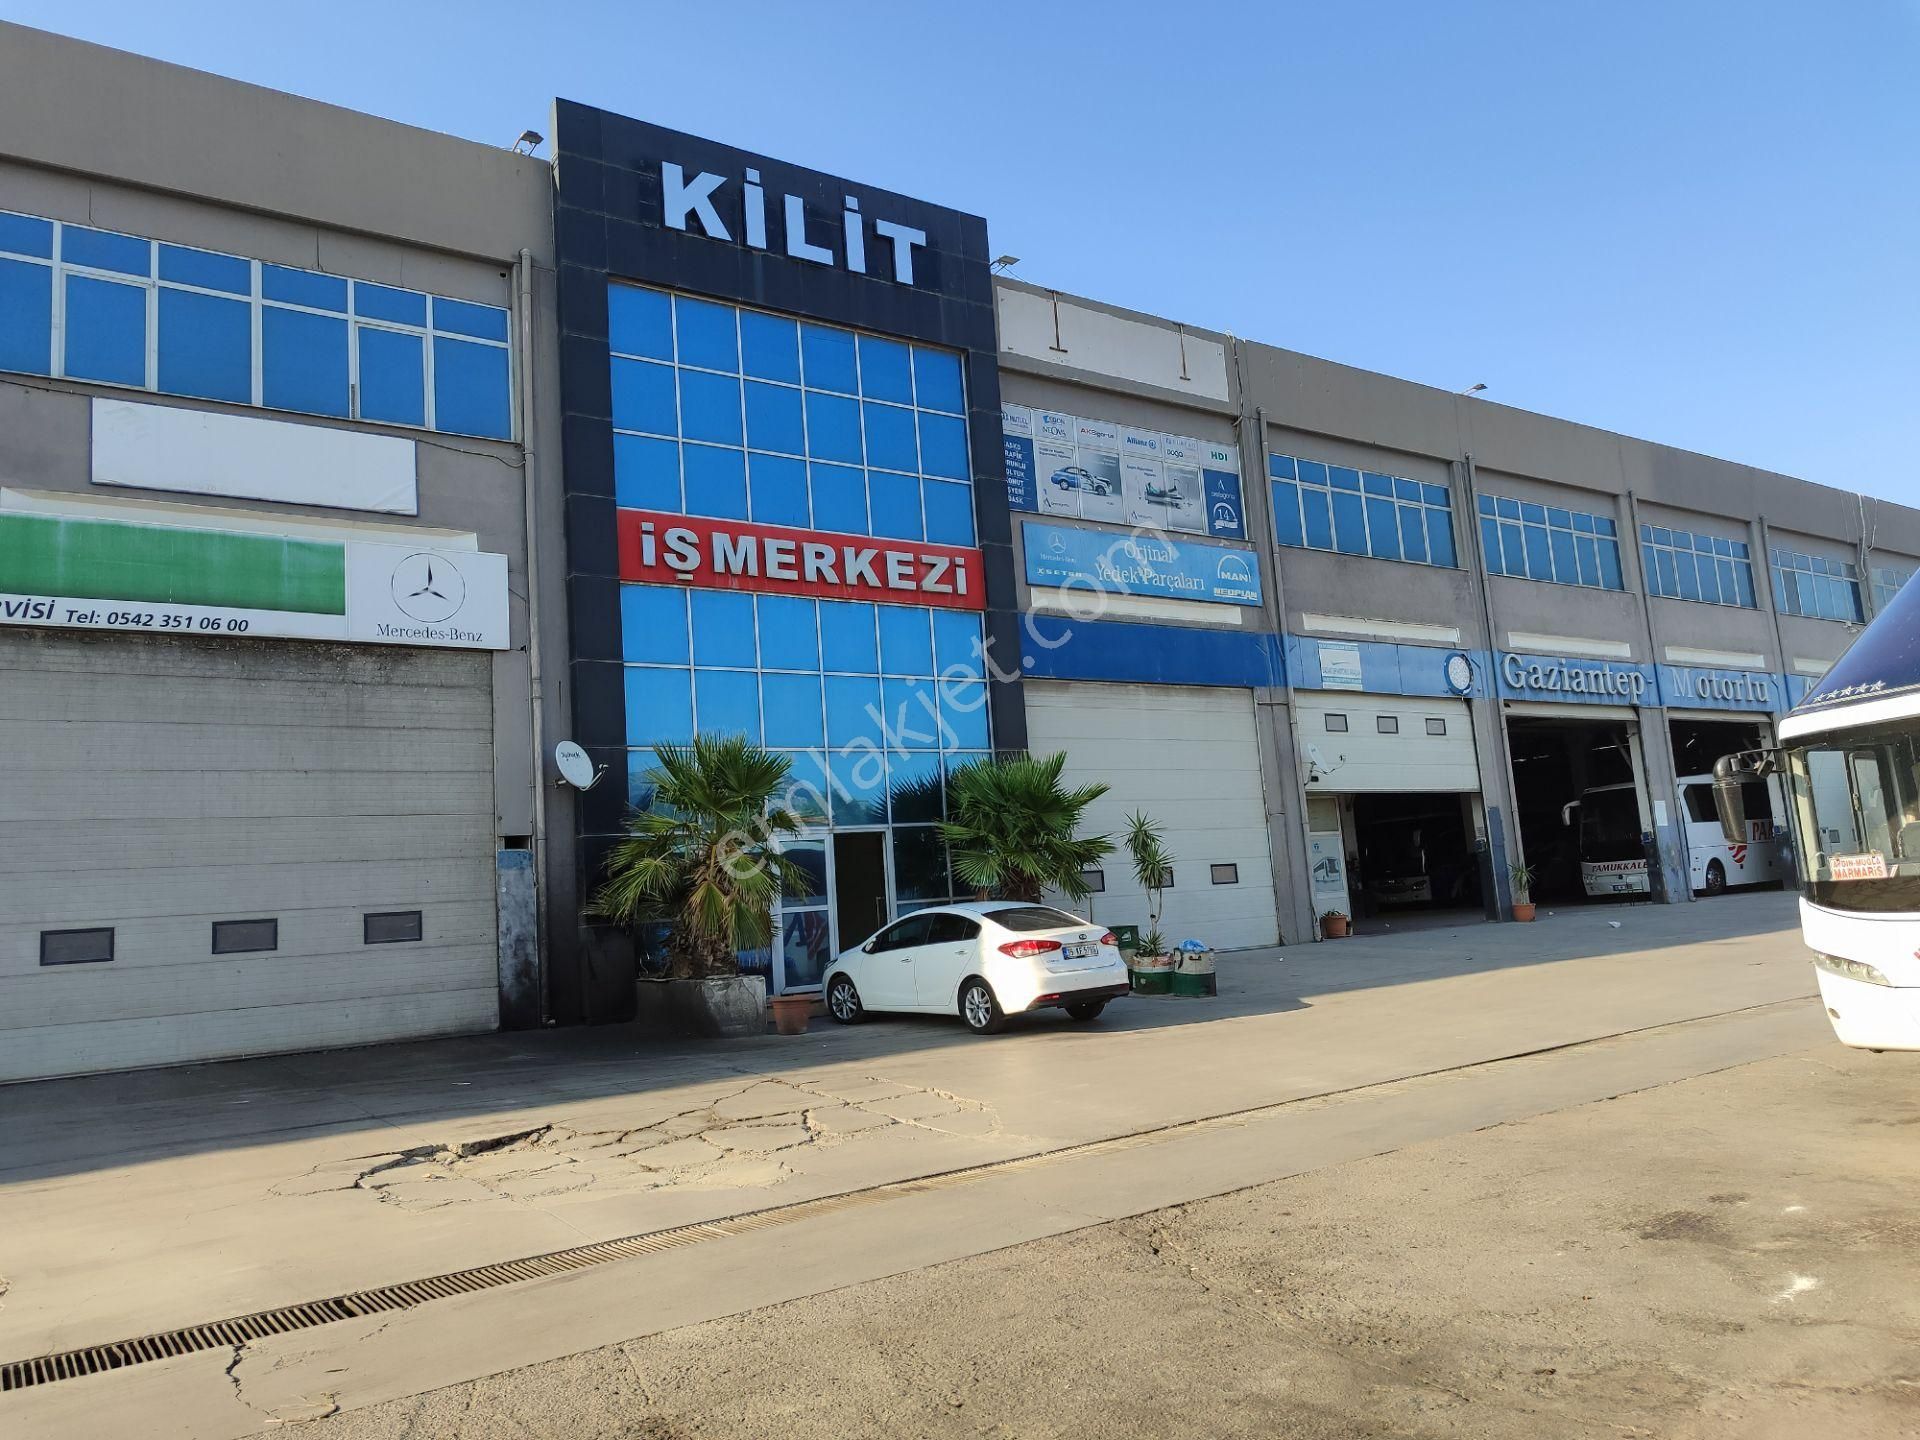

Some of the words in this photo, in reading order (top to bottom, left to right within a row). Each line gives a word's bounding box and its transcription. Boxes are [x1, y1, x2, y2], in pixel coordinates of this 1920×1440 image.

[661, 161, 926, 285] KİLİT
[1126, 436, 1148, 447] Allianz
[1210, 450, 1228, 462] HDI
[640, 522, 701, 580] İŞ
[711, 532, 967, 595] MERKEZİ
[1124, 541, 1173, 564] Orjinal
[1095, 562, 1139, 584] Yedek
[1143, 568, 1206, 592] Parçaları
[1220, 571, 1249, 583] MAN
[0, 598, 55, 620] visi
[66, 609, 101, 625] Tel:
[107, 611, 154, 628] 0542
[159, 614, 193, 629] 351
[199, 616, 222, 631] 06
[227, 618, 249, 633] 00
[376, 623, 483, 642] Mercedes-Benz
[1502, 653, 1645, 705] Gaziantep
[1670, 666, 1769, 702] Motorlu
